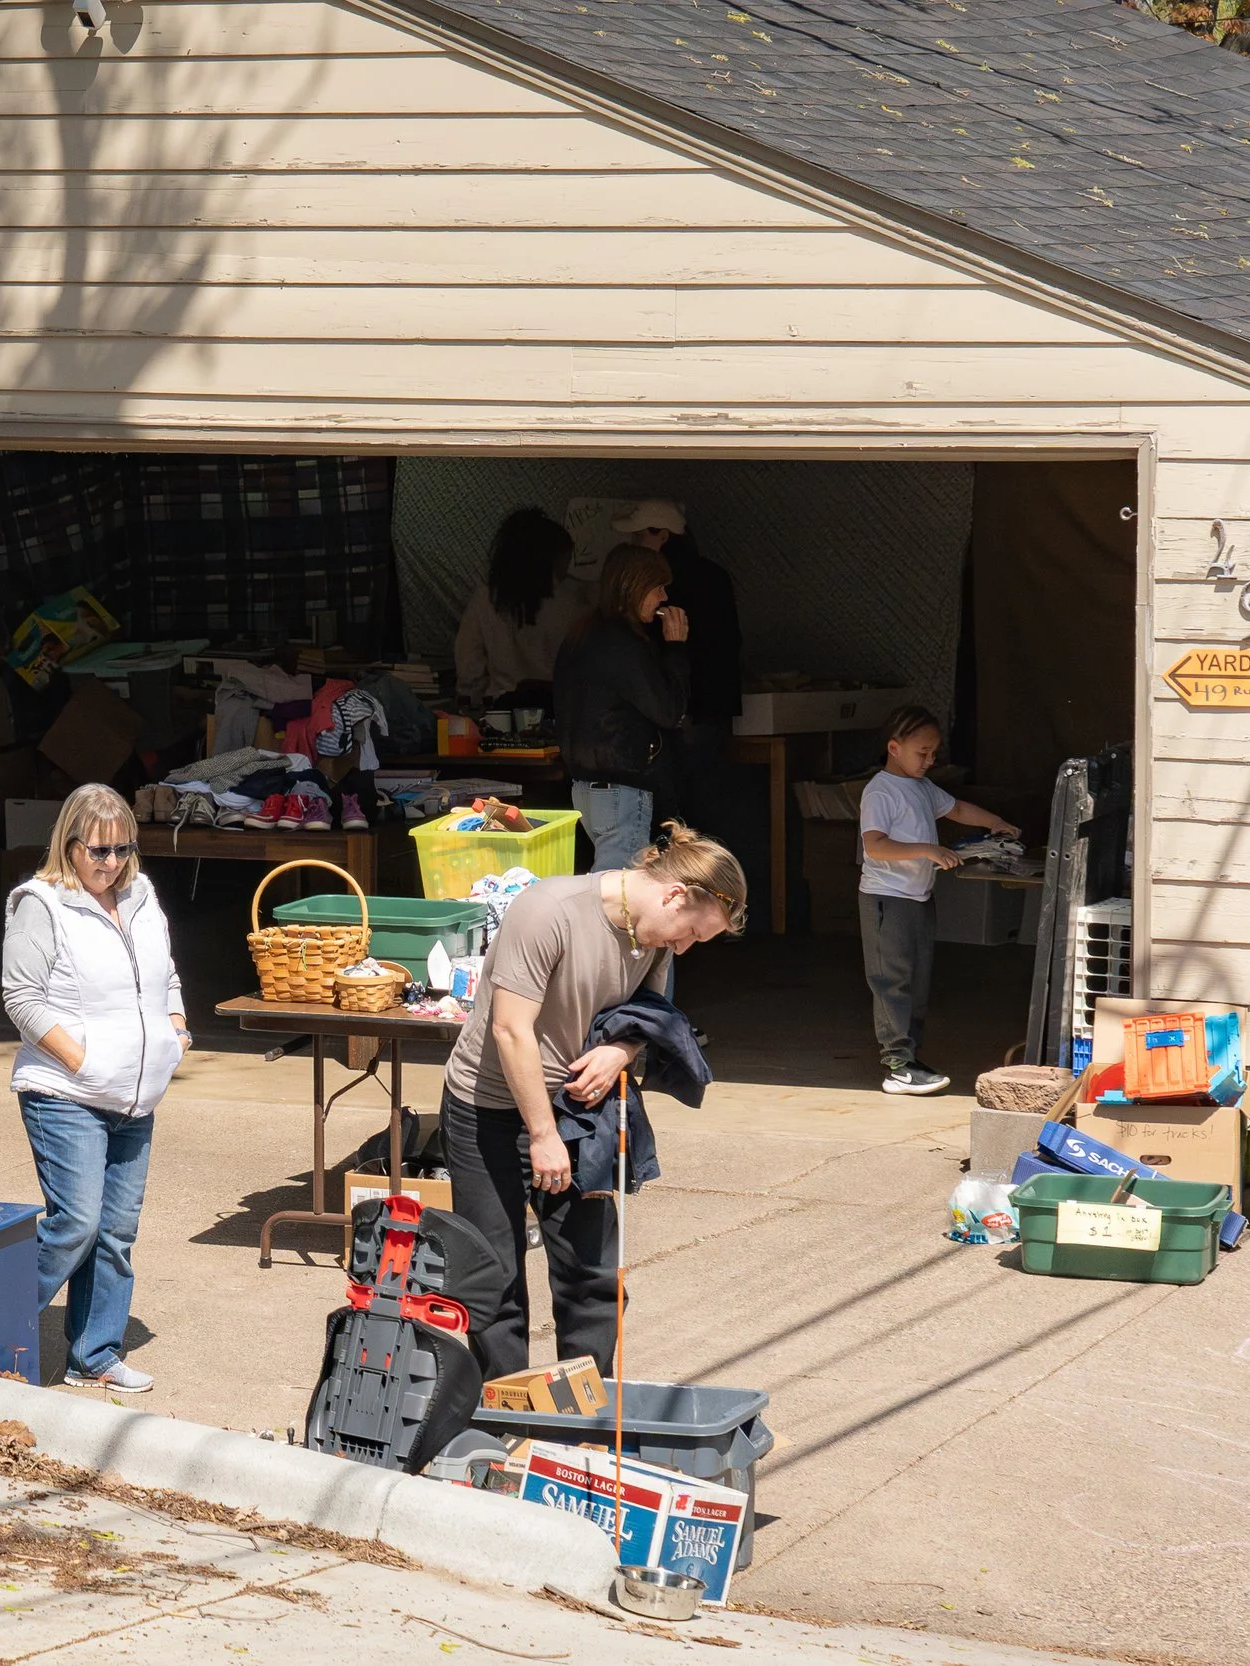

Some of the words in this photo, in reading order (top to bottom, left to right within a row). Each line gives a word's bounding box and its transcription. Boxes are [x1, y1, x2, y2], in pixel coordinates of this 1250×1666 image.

[1196, 654, 1250, 671] YARD
[1233, 685, 1250, 695] Ru
[1142, 1124, 1157, 1138] for
[501, 1390, 528, 1398] DOUBLEC
[556, 1466, 591, 1485] BOSTON
[708, 1509, 727, 1518] LAGER
[671, 1520, 726, 1548] SAMUEL
[671, 1541, 719, 1566] ADAMS
